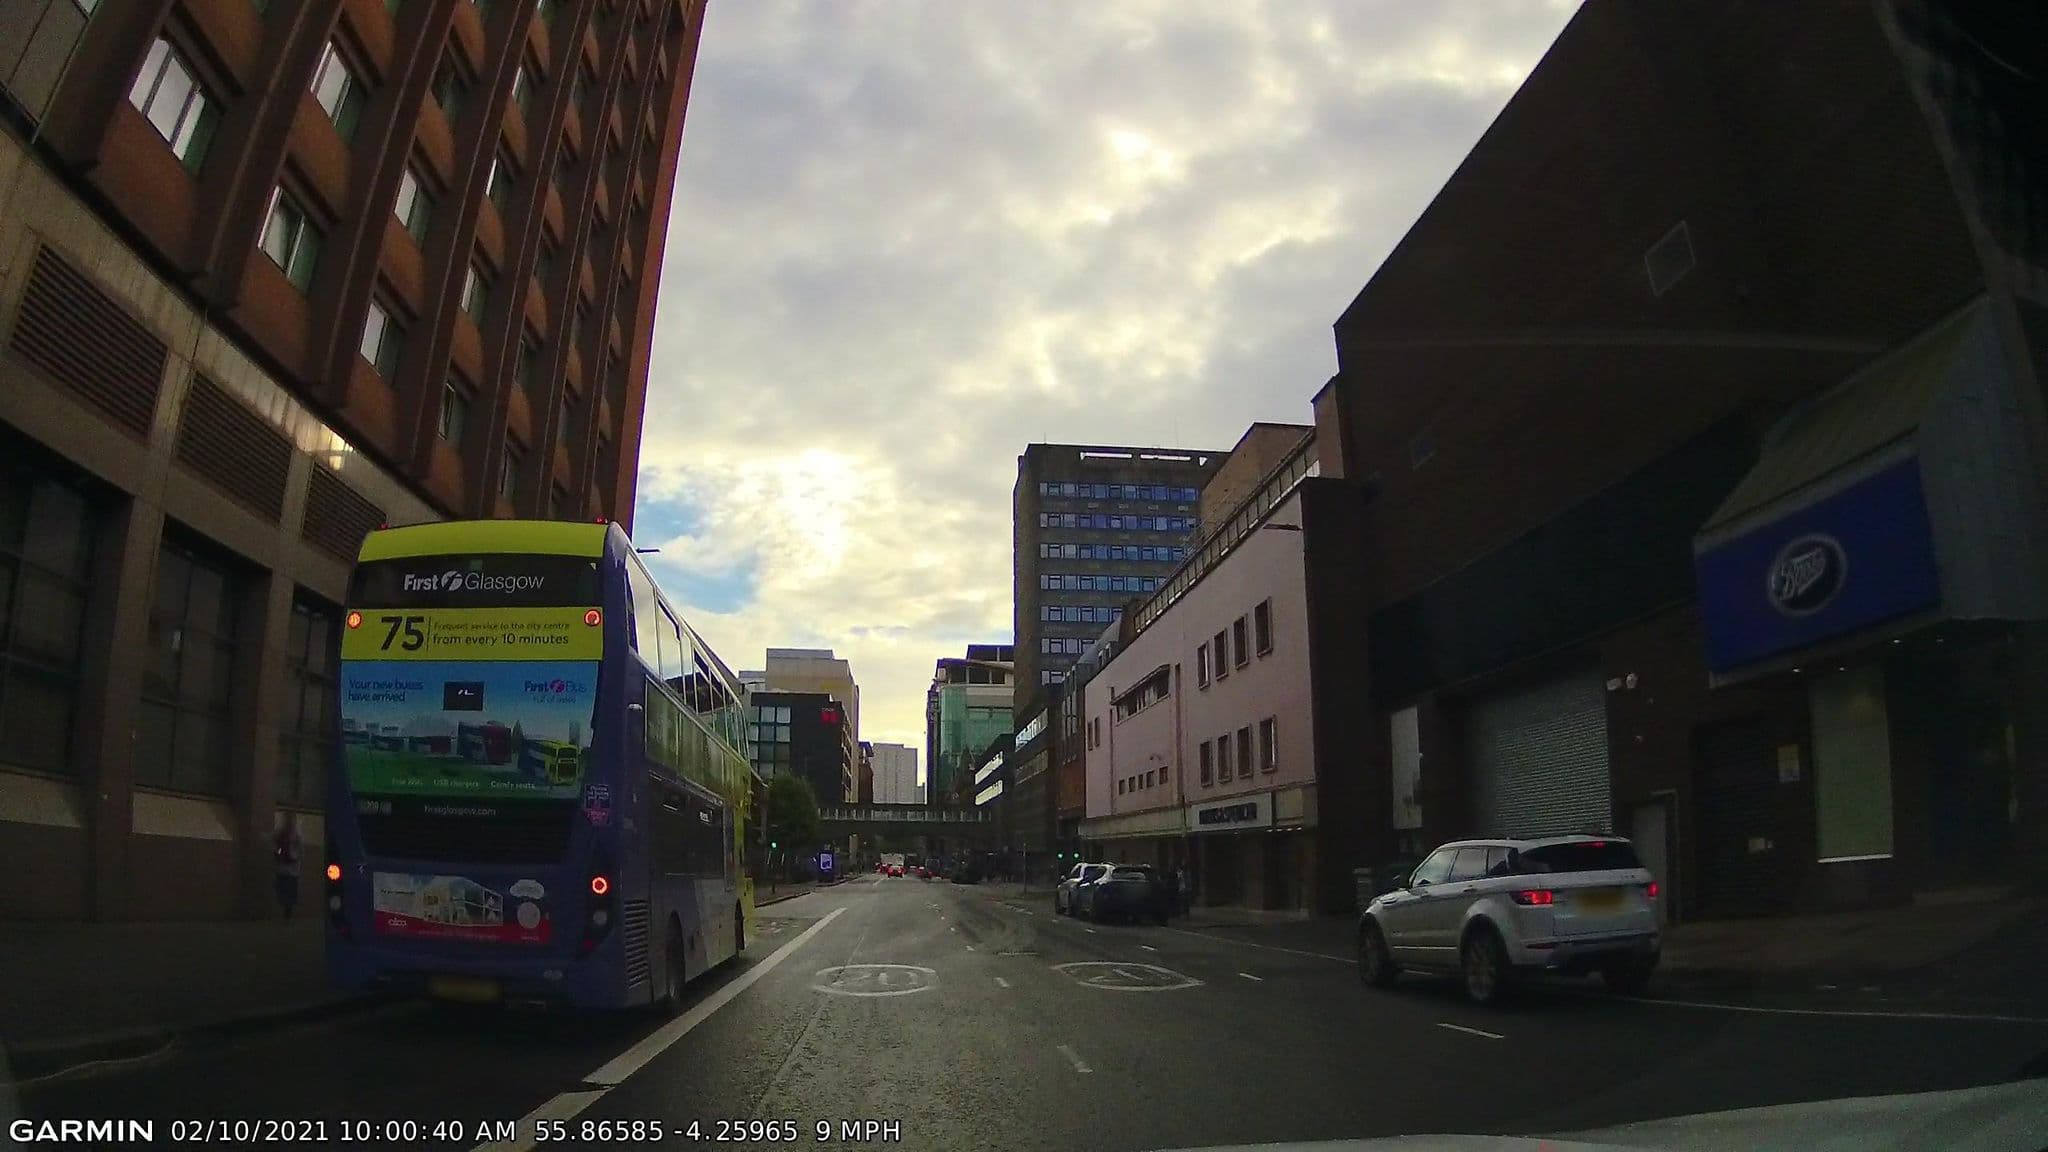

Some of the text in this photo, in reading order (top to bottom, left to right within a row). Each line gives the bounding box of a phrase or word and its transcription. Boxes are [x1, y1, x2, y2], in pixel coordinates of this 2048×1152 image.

[403, 572, 545, 594] First Glasgow
[511, 621, 525, 630] the
[381, 616, 425, 651] 75
[432, 632, 569, 647] from every 10 minutes
[349, 679, 371, 690] Your
[524, 681, 550, 693] First
